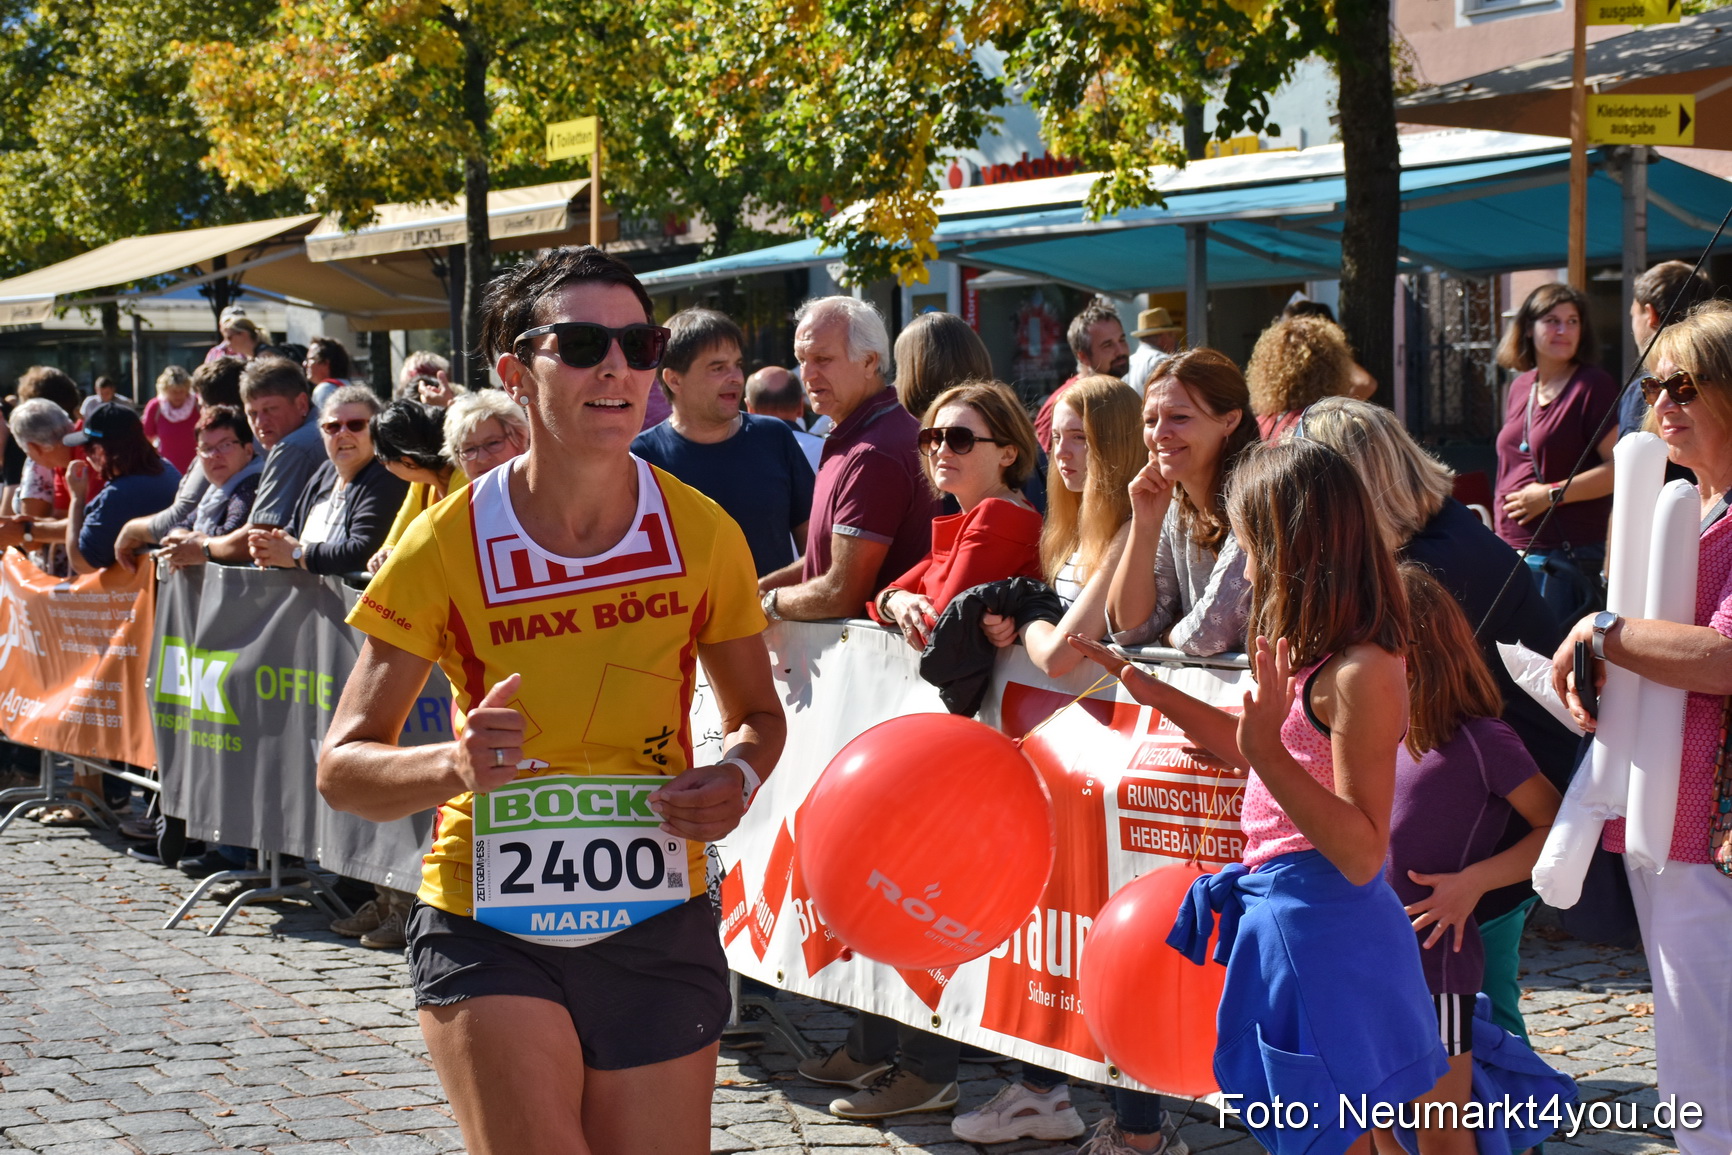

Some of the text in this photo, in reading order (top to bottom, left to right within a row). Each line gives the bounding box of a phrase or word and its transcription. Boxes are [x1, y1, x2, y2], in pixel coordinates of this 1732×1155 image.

[1599, 4, 1645, 21] ausgabe
[1596, 103, 1672, 118] Kleiderbeutel-
[556, 131, 593, 149] Toiletten
[1610, 121, 1656, 137] ausgabe
[489, 590, 689, 646] MAX BÖGL
[491, 785, 665, 828] BOCK
[668, 842, 677, 852] D
[1129, 826, 1243, 859] HEBEBÄNDER
[499, 837, 665, 895] 2400
[530, 908, 632, 932] MARIA
[1028, 980, 1057, 1008] Sicher
[1060, 989, 1076, 1012] ist
